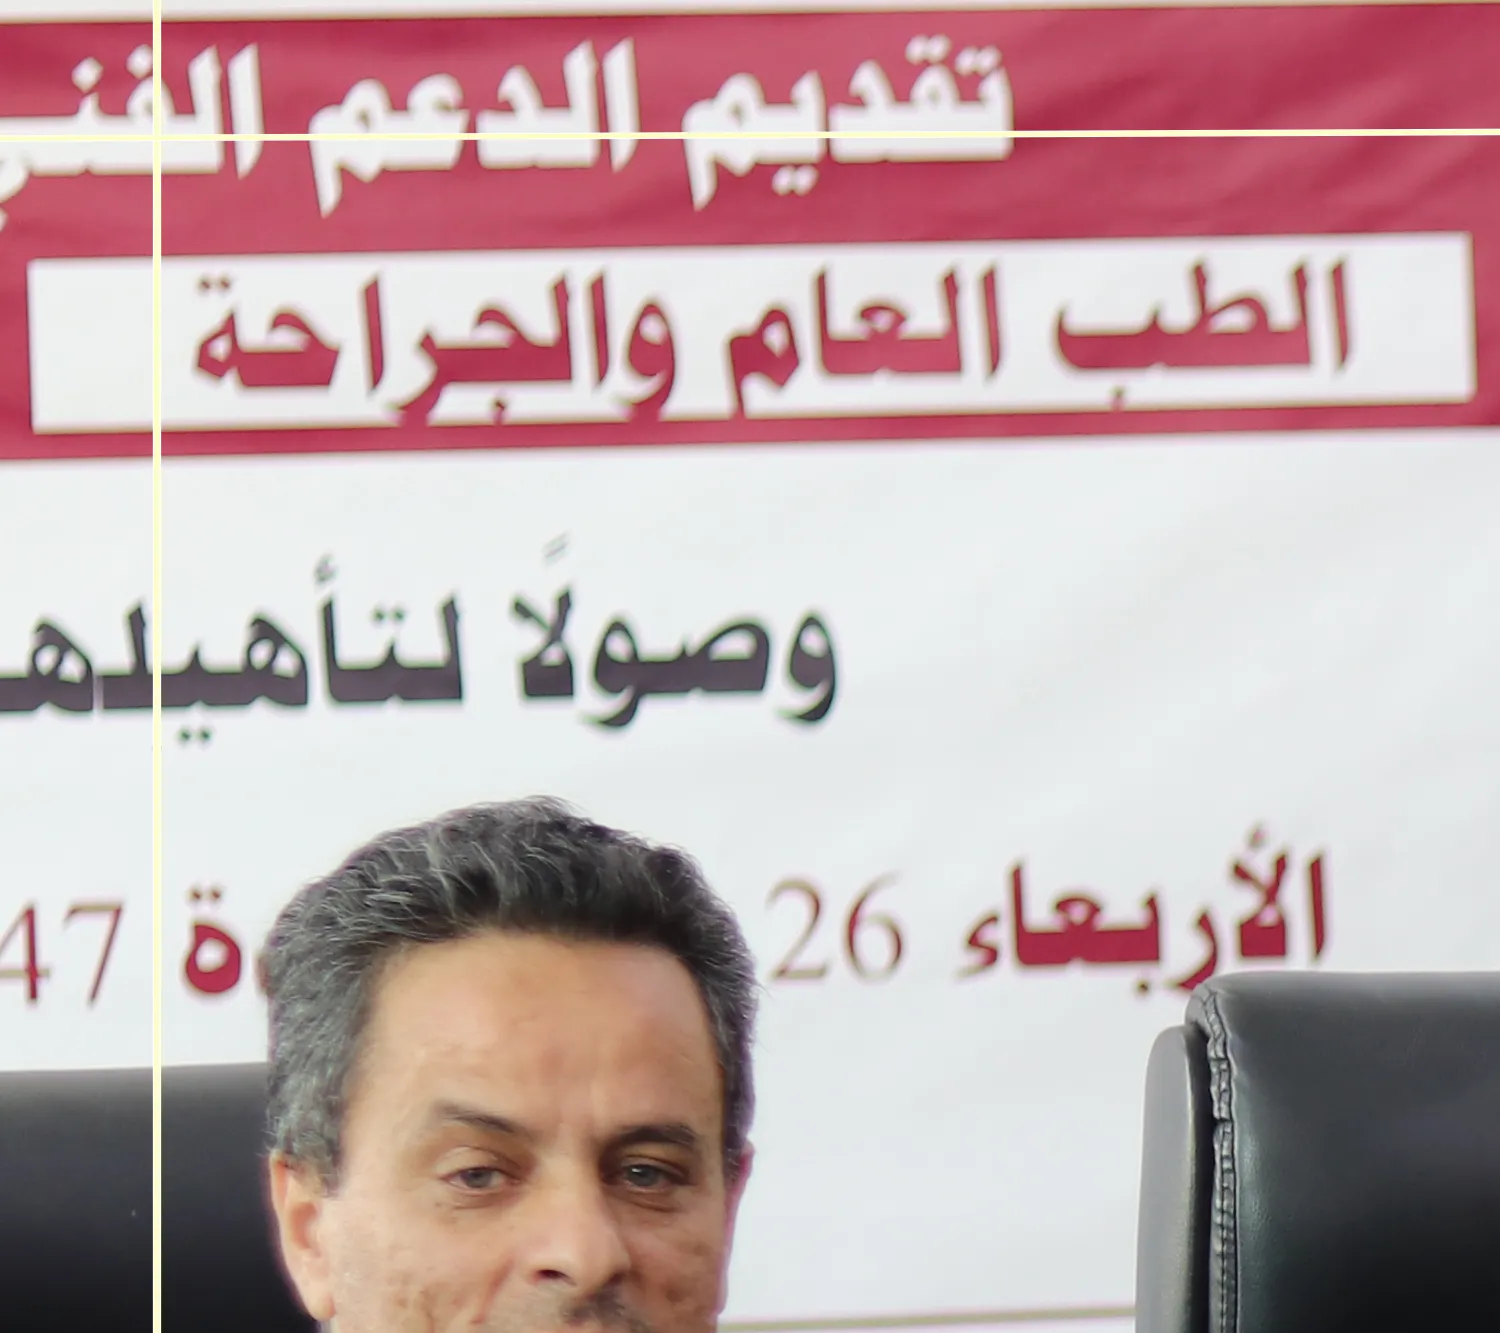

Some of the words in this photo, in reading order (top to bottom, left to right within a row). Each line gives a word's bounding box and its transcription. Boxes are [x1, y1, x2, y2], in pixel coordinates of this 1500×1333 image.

[308, 37, 640, 218] الدعم
[682, 34, 1014, 211] تقديم
[193, 265, 676, 425] والجراحة
[727, 260, 1003, 418] العام
[1055, 255, 1352, 411] الطب
[0, 553, 464, 744] لتأهيله
[766, 870, 908, 984] 26
[957, 821, 1329, 993] الأربعاء
